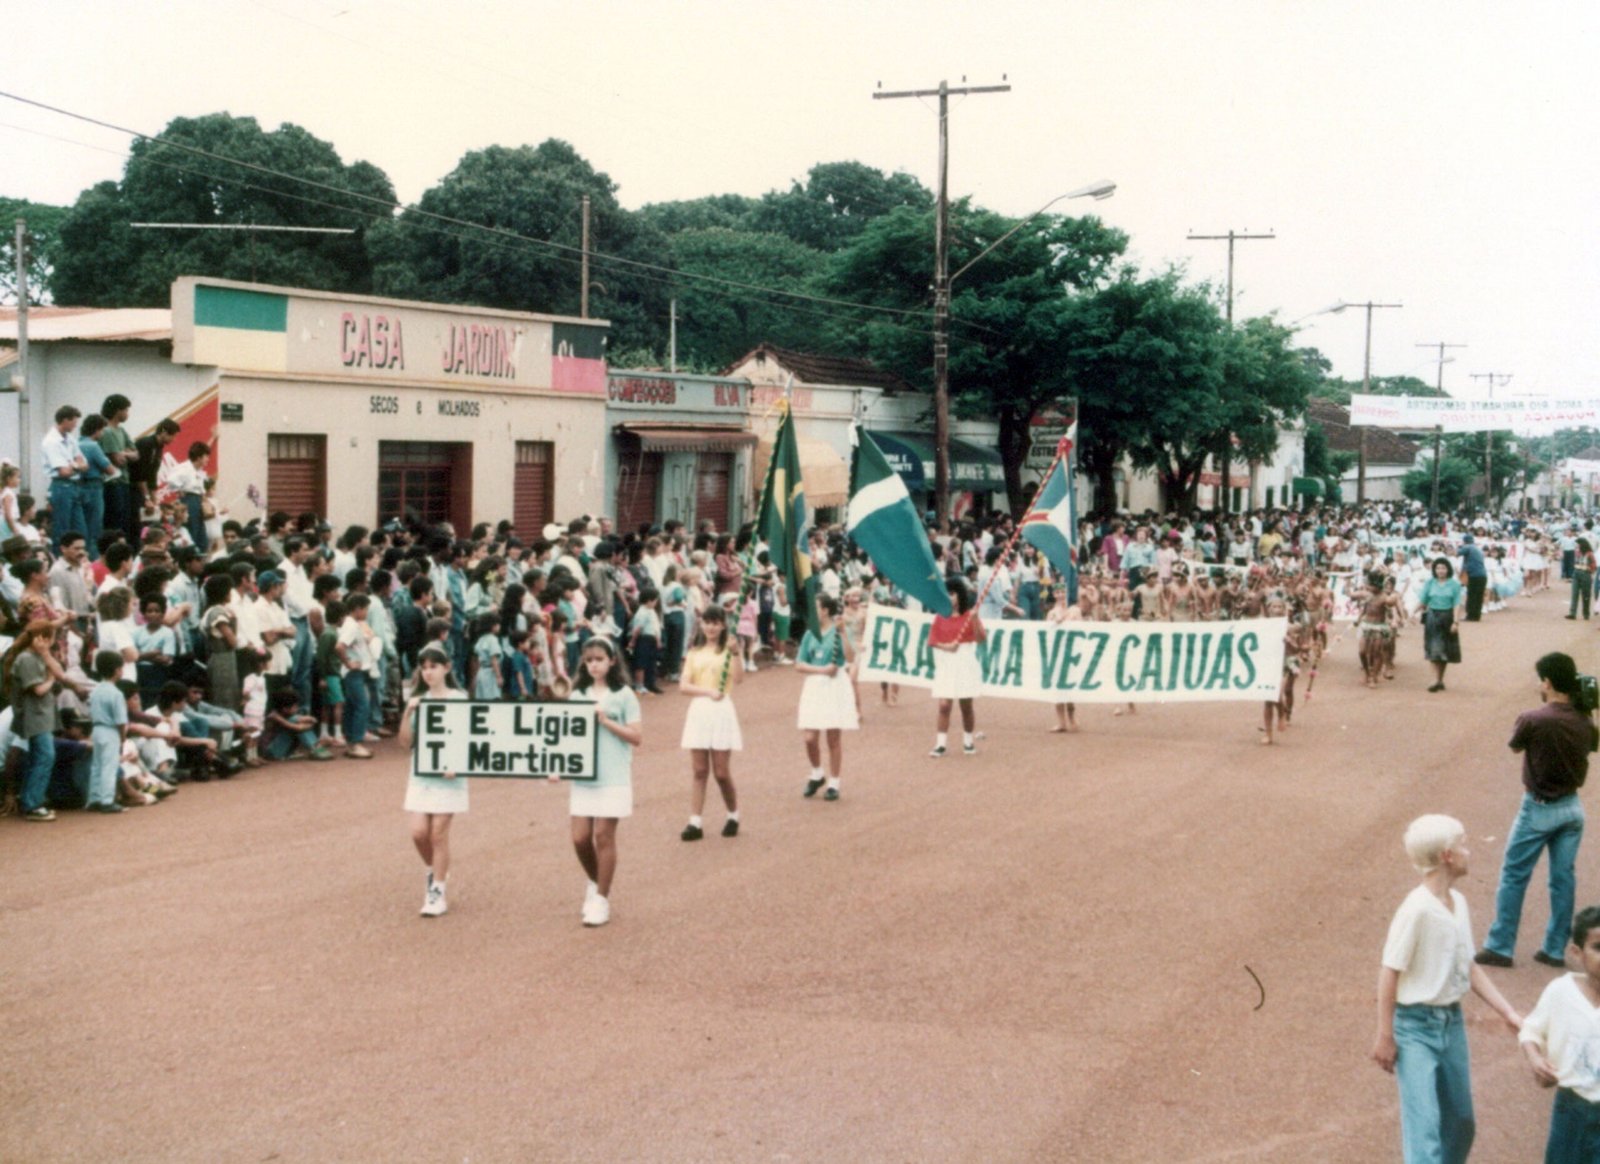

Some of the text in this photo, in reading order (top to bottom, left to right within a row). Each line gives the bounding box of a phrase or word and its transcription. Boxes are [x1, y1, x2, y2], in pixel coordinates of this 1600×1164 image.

[339, 311, 405, 370] CASA
[370, 395, 399, 413] SECOS
[438, 399, 480, 417] MOLHADOS
[868, 615, 936, 679] ERA
[976, 629, 1023, 687] MA
[1037, 629, 1110, 691] VEZ
[426, 705, 587, 746] E. E. Lígia
[426, 741, 583, 774] T. Martins
